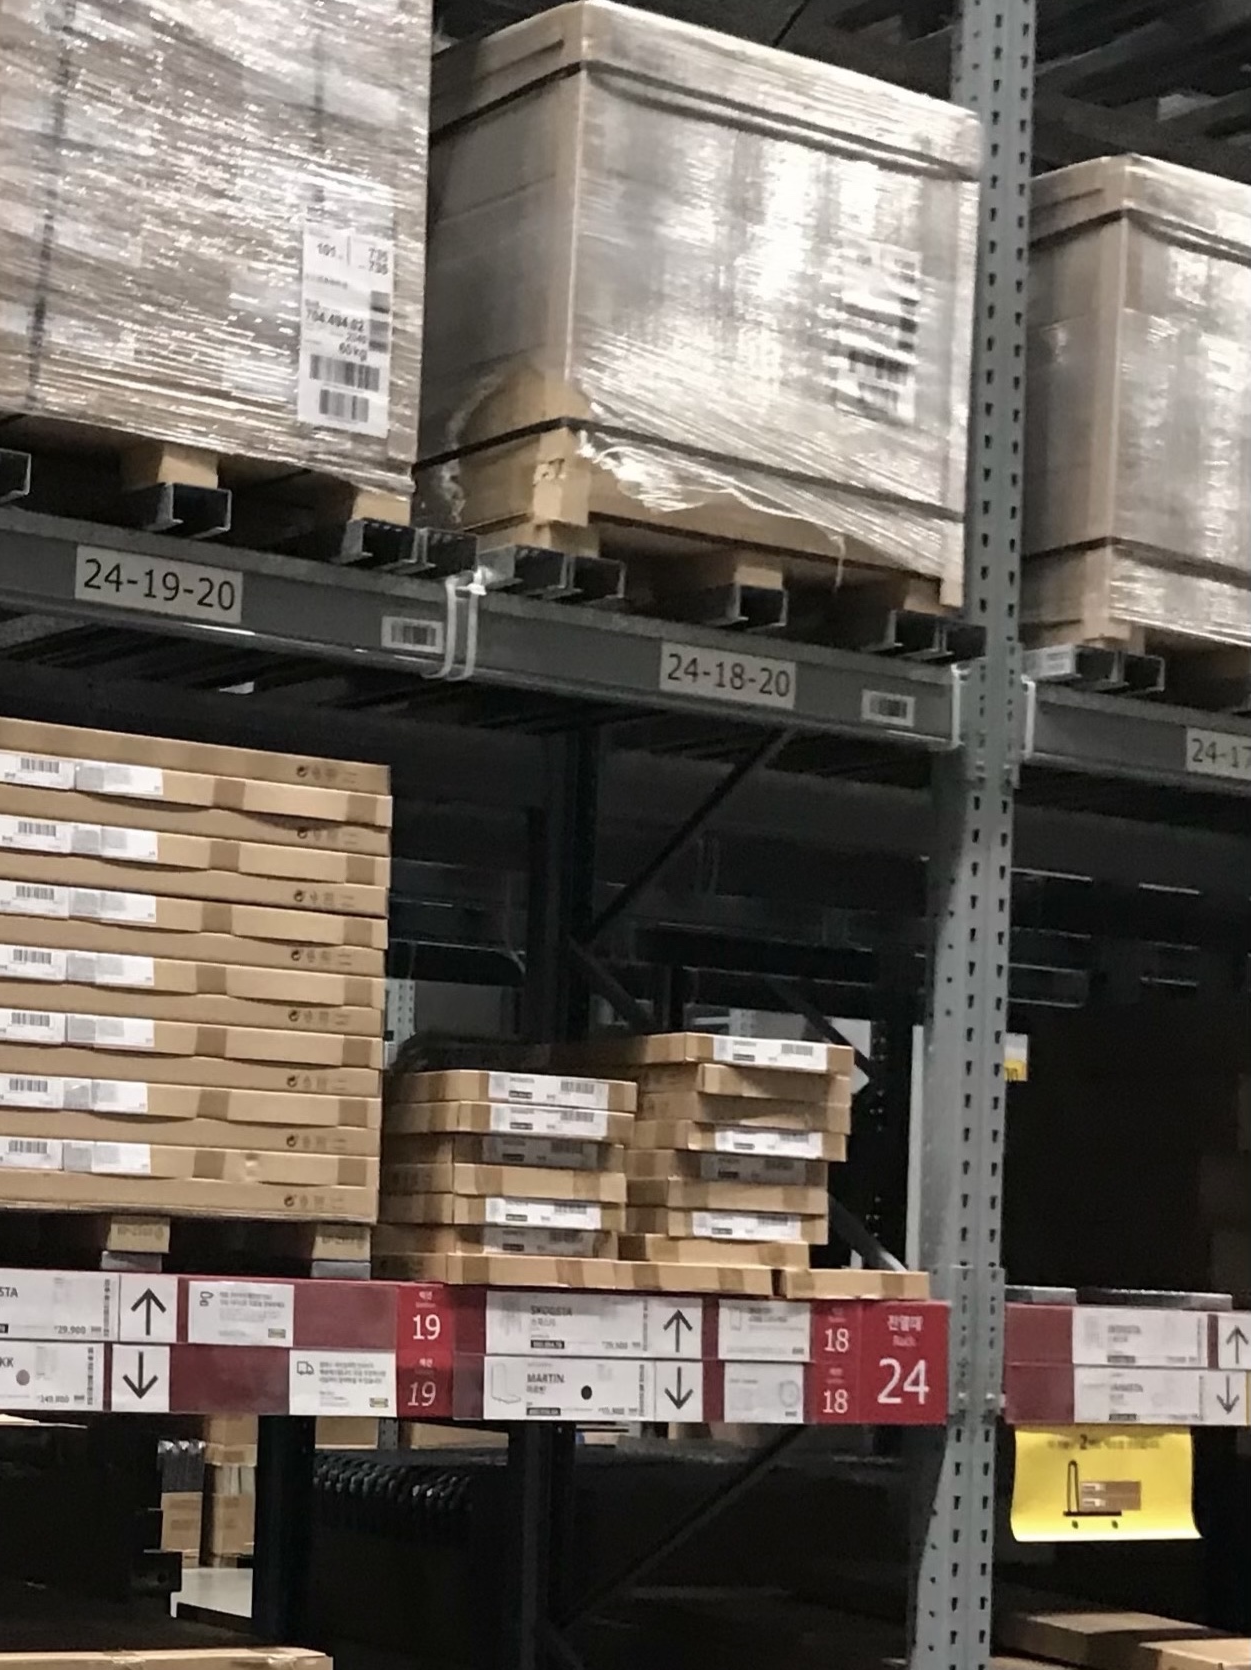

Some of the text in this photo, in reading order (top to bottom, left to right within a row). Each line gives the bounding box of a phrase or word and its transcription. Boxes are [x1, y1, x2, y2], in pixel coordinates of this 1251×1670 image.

[84, 558, 235, 611] 24-19-20
[667, 653, 790, 697] 24-18-20
[412, 1314, 441, 1341] 19
[824, 1328, 849, 1353] 18
[527, 1373, 565, 1384] MARTIN
[877, 1357, 930, 1405] 24
[407, 1381, 436, 1407] 19
[822, 1388, 848, 1414] 18
